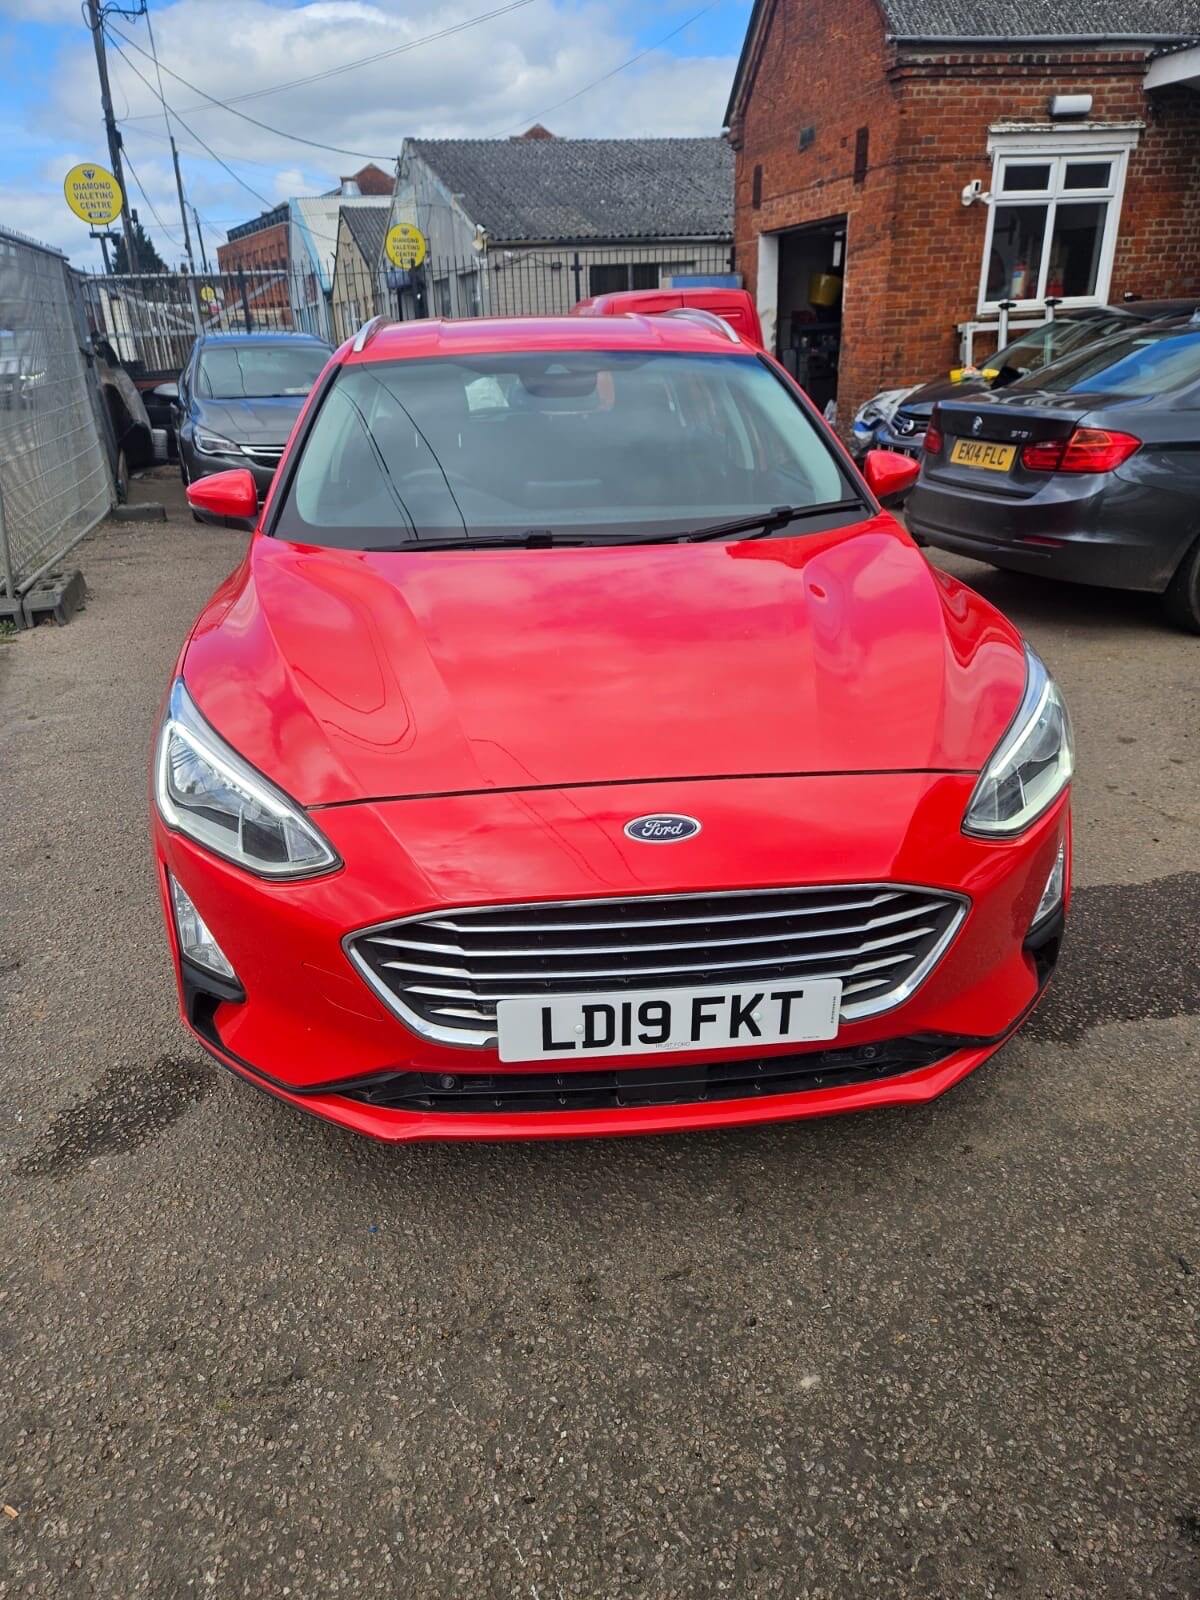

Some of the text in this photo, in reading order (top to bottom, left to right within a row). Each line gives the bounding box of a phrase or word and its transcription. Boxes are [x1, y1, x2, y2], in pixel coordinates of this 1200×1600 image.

[72, 182, 111, 191] DIAMOND
[73, 191, 114, 200] VALETING
[80, 201, 112, 209] CENTRE
[957, 442, 1008, 466] EK14 FLC
[641, 819, 684, 837] Ford
[541, 1000, 672, 1051] LD19
[690, 990, 804, 1042] FKT
